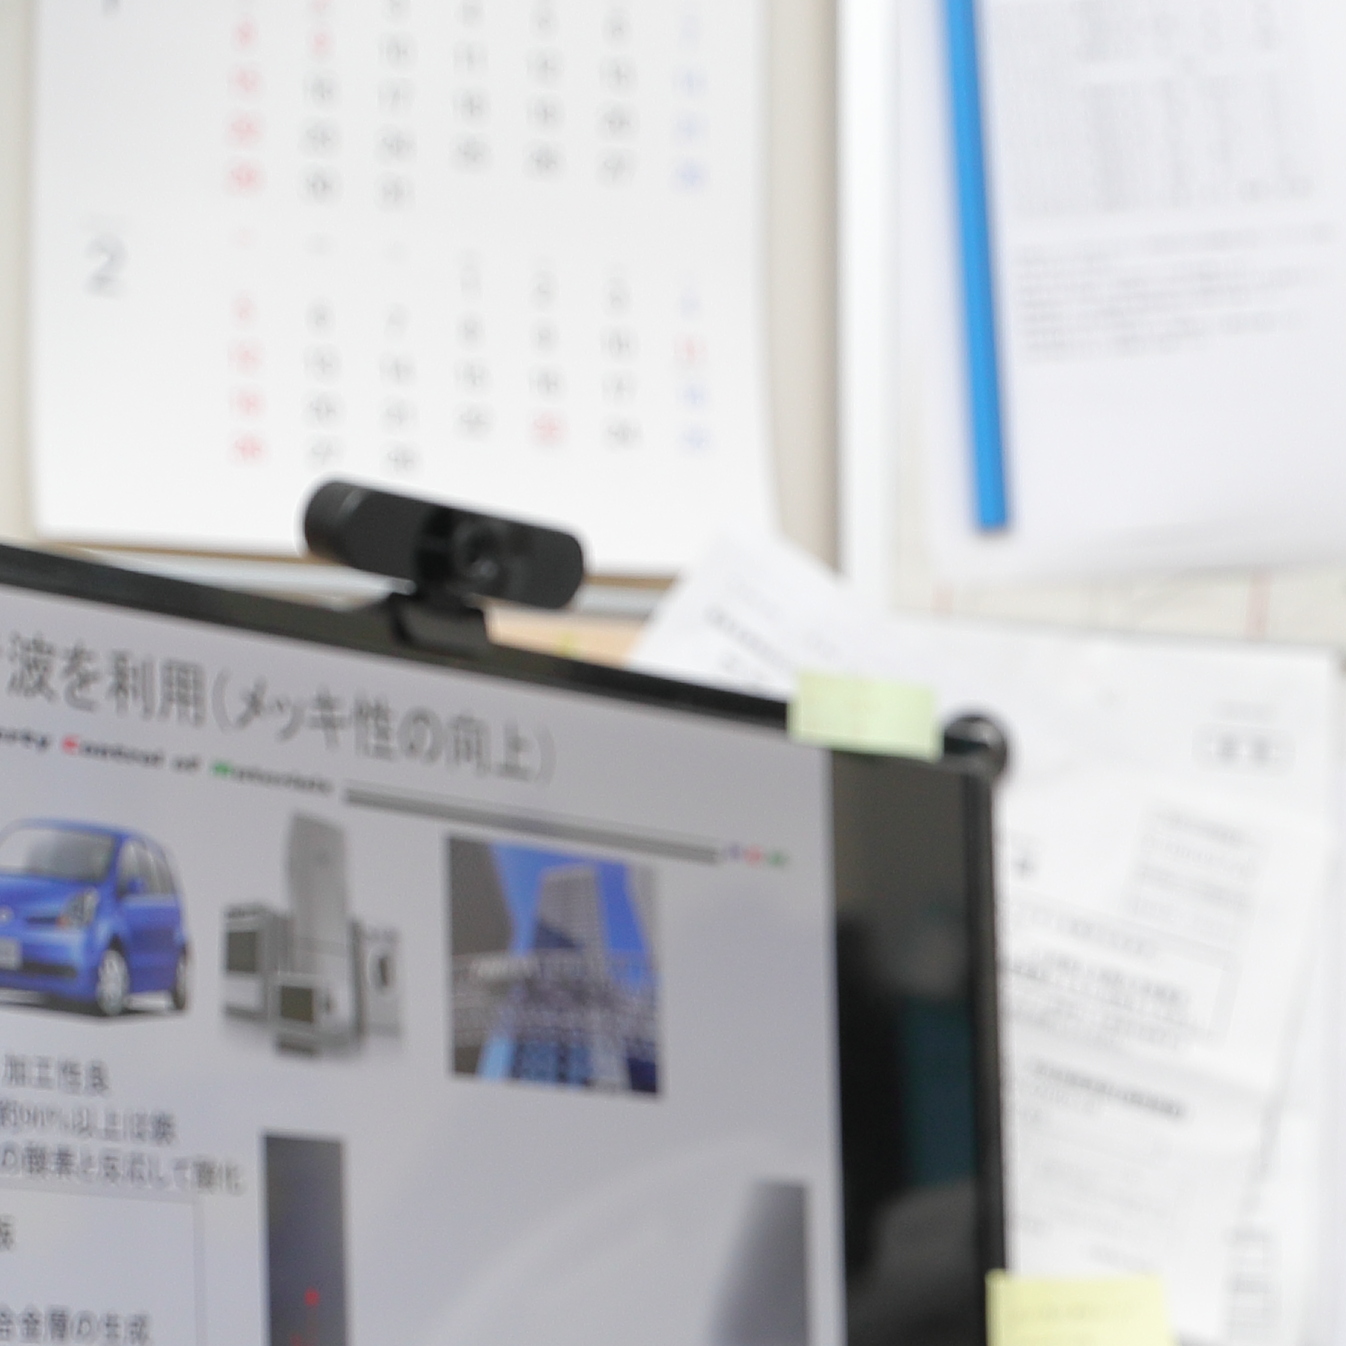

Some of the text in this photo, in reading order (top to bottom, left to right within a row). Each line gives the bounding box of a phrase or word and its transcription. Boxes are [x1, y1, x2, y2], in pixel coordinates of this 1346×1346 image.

[0, 630, 557, 784] 波を利用(メッキ性の向上)
